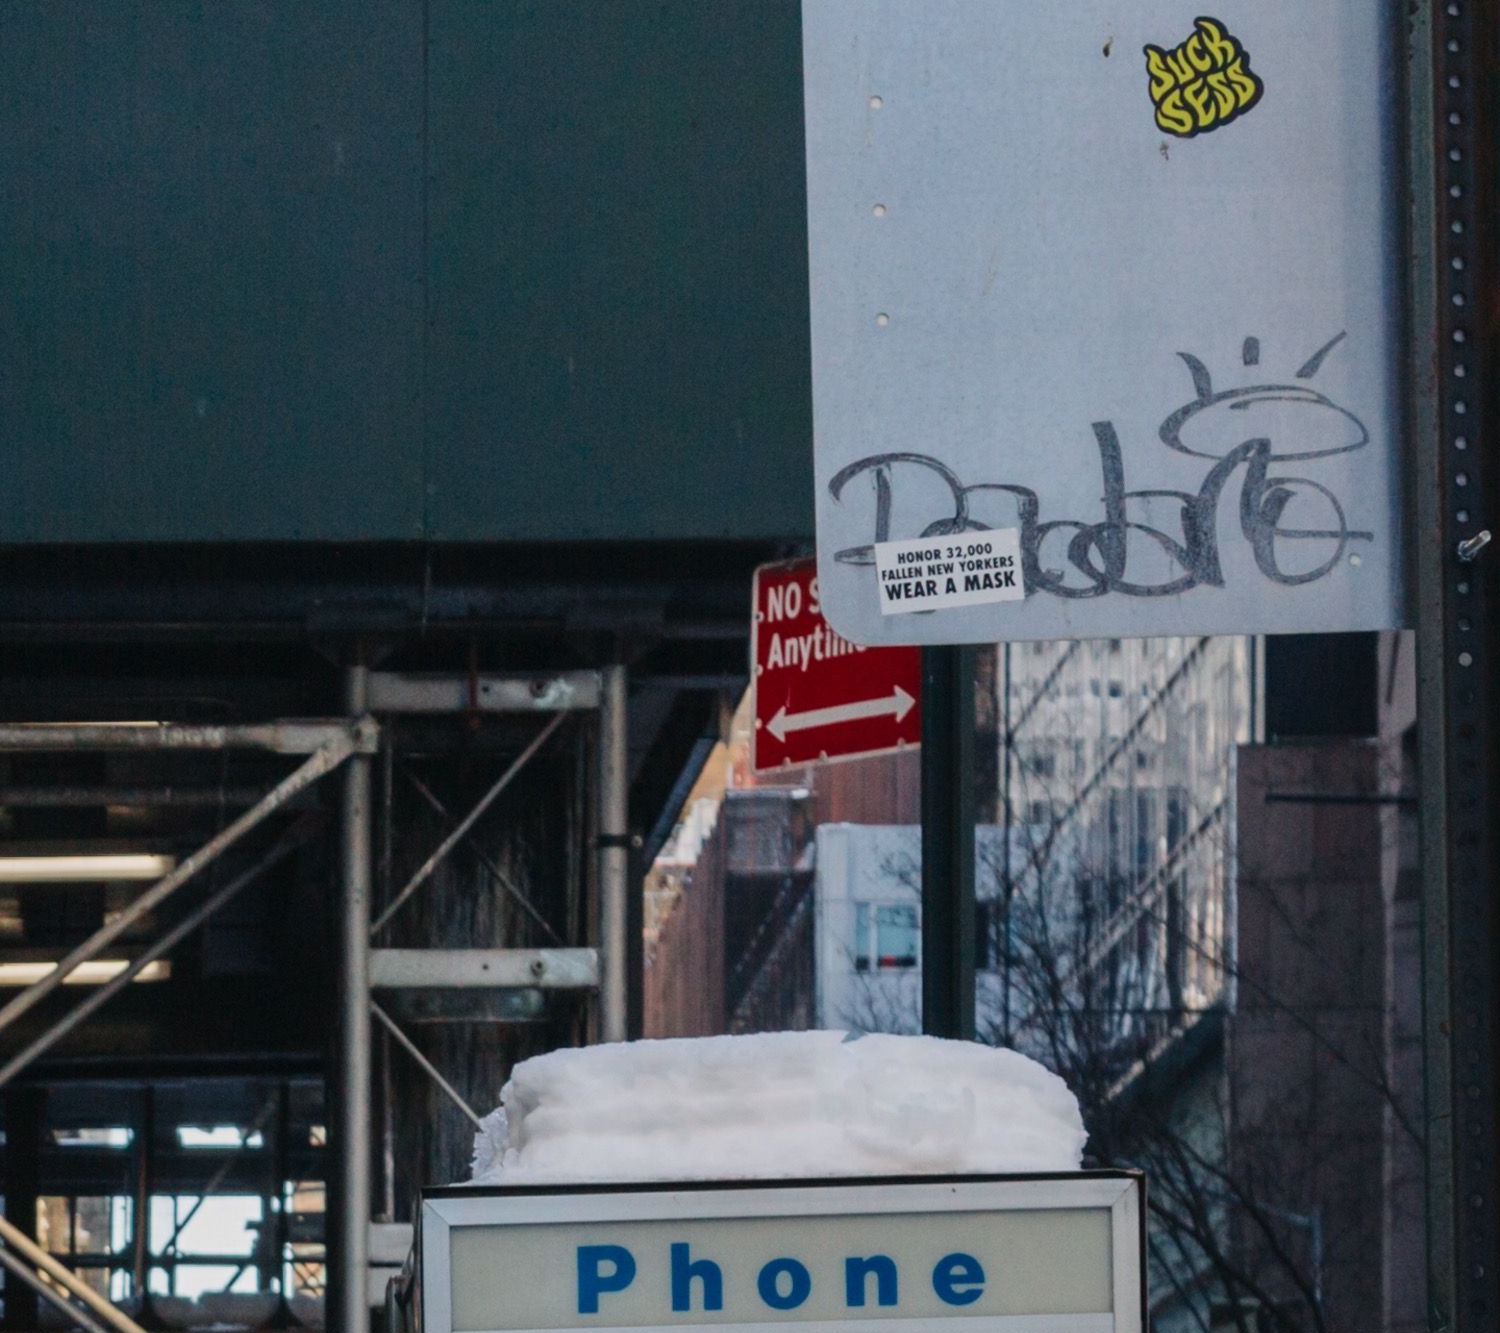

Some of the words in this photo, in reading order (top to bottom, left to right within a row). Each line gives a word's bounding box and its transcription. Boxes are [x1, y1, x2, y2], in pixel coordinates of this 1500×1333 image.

[881, 566, 923, 582] FALLEN
[927, 562, 954, 577] NEW
[958, 555, 1014, 573] YORKERS
[897, 548, 942, 565] HONOR
[946, 542, 993, 559] 32,000
[884, 579, 938, 601] WEAR
[945, 578, 957, 594] A
[964, 570, 1016, 592] MASK
[767, 582, 802, 623] NO
[575, 1242, 987, 1315] Phone
